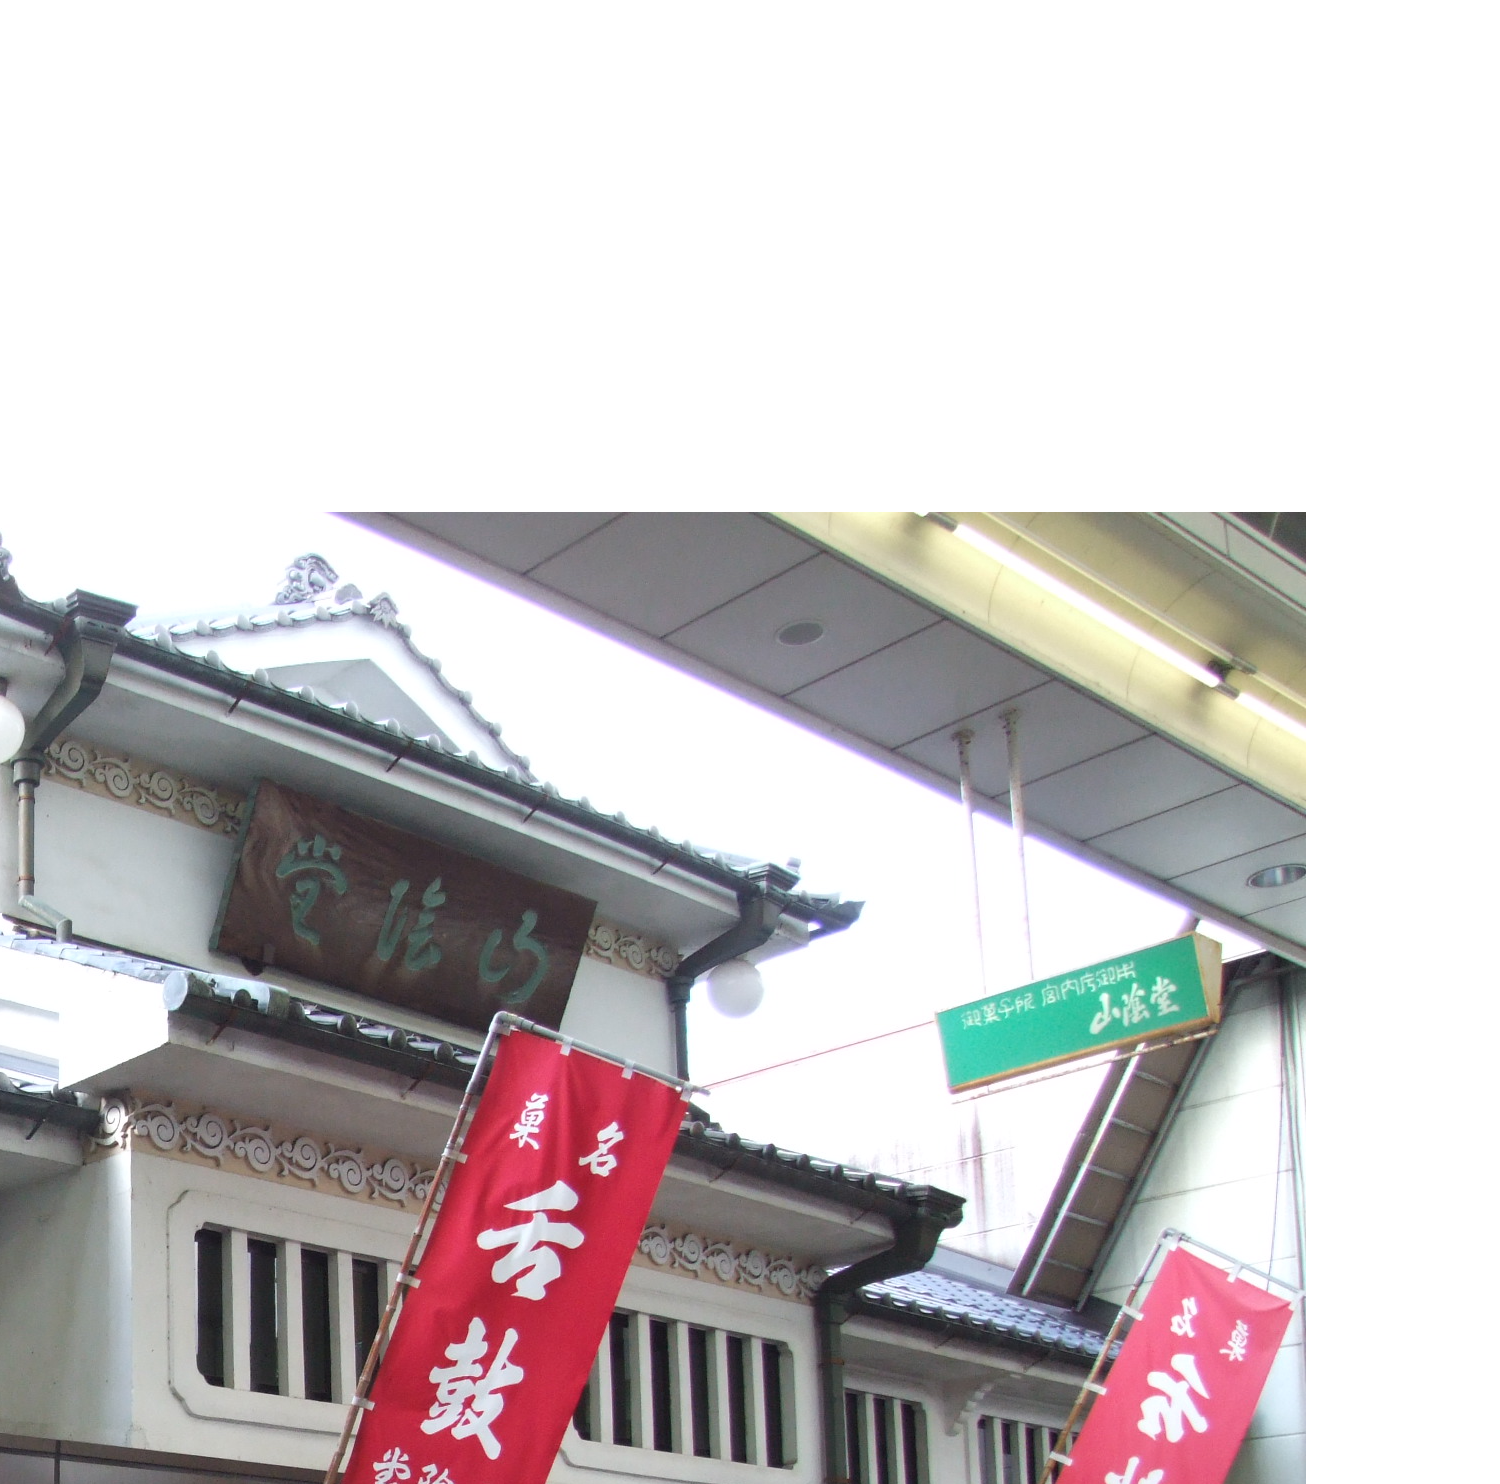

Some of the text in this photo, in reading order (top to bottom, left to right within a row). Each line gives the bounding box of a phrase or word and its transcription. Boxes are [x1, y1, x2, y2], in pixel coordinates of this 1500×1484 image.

[1089, 975, 1180, 1034] 山陰堂
[510, 1092, 624, 1178] 名菓
[420, 1180, 585, 1462] 舌鼓
